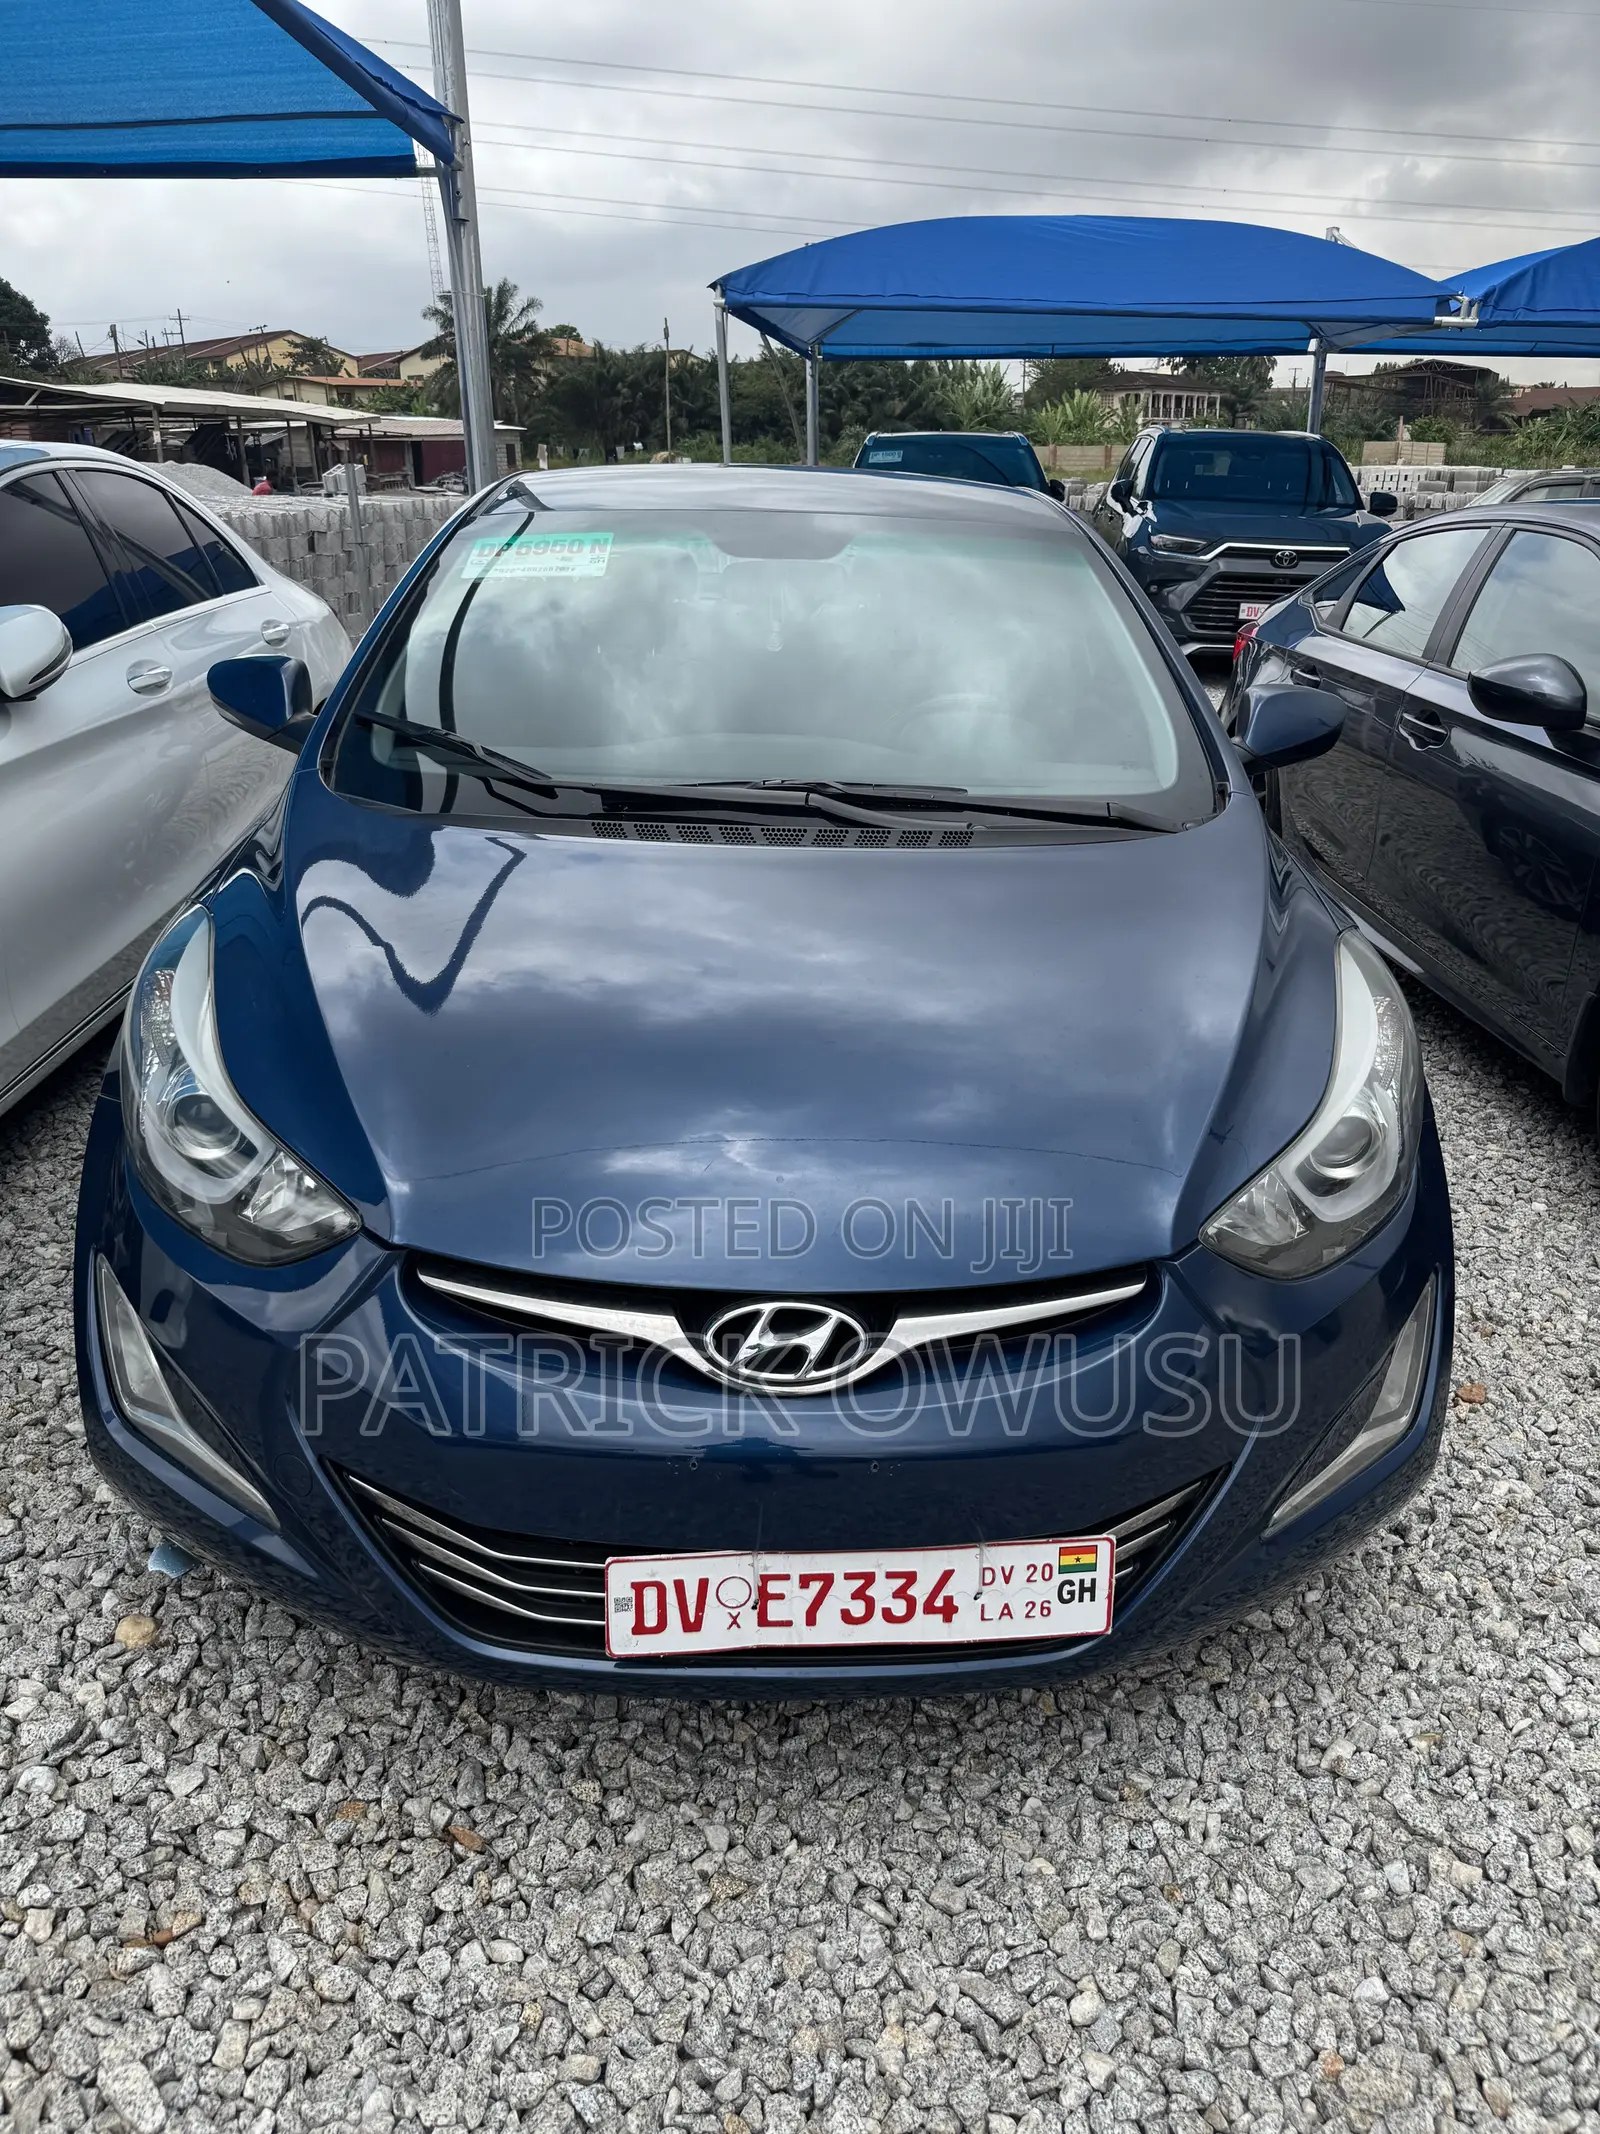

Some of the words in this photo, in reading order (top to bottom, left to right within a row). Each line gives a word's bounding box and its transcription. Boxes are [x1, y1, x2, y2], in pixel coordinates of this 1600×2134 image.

[515, 538, 585, 555] 5950
[590, 539, 609, 553] N
[1246, 606, 1260, 617] DV
[981, 1565, 1015, 1586] DV
[1026, 1563, 1054, 1583] 20
[630, 1577, 709, 1636] DV
[727, 1611, 741, 1630] X
[757, 1568, 959, 1628] E7334
[1057, 1577, 1097, 1605] GH
[980, 1602, 1014, 1622] LA
[1024, 1600, 1052, 1619] 26
